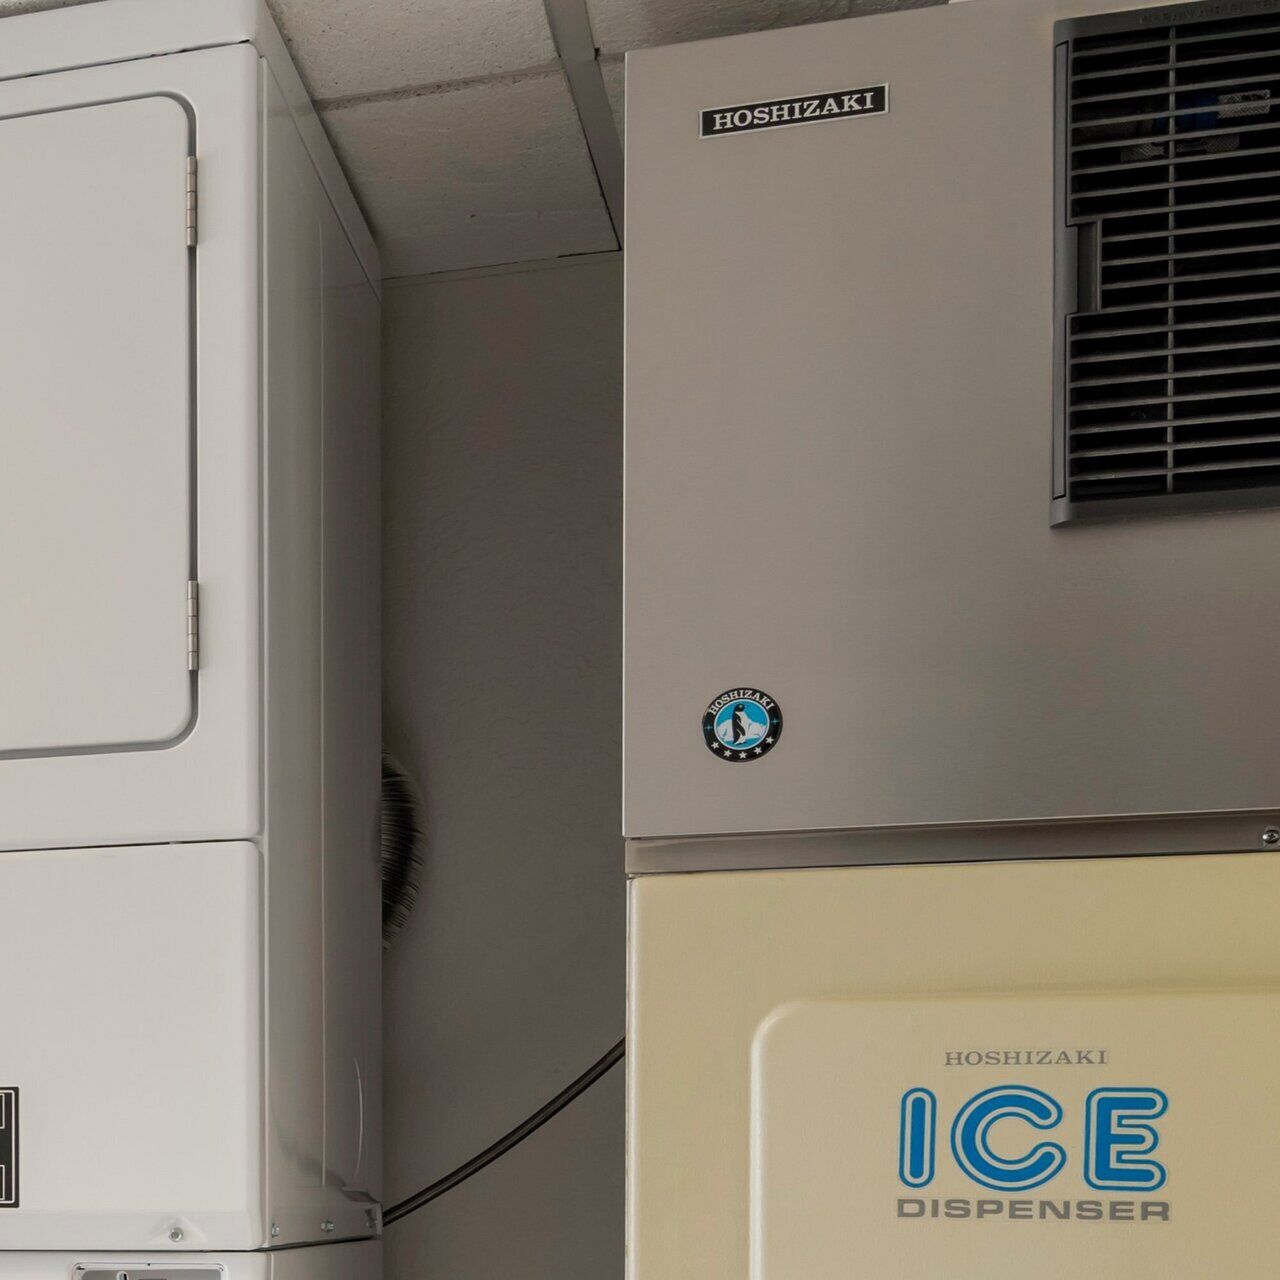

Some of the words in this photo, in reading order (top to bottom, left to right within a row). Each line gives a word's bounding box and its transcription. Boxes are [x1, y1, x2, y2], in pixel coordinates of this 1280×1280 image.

[713, 92, 874, 130] HOSHIZAKI
[708, 689, 775, 715] HOSHIZAKI
[944, 1050, 1109, 1066] HOSHIZAKI
[899, 1084, 1169, 1192] ICE
[897, 1199, 1170, 1221] DISPENSER
